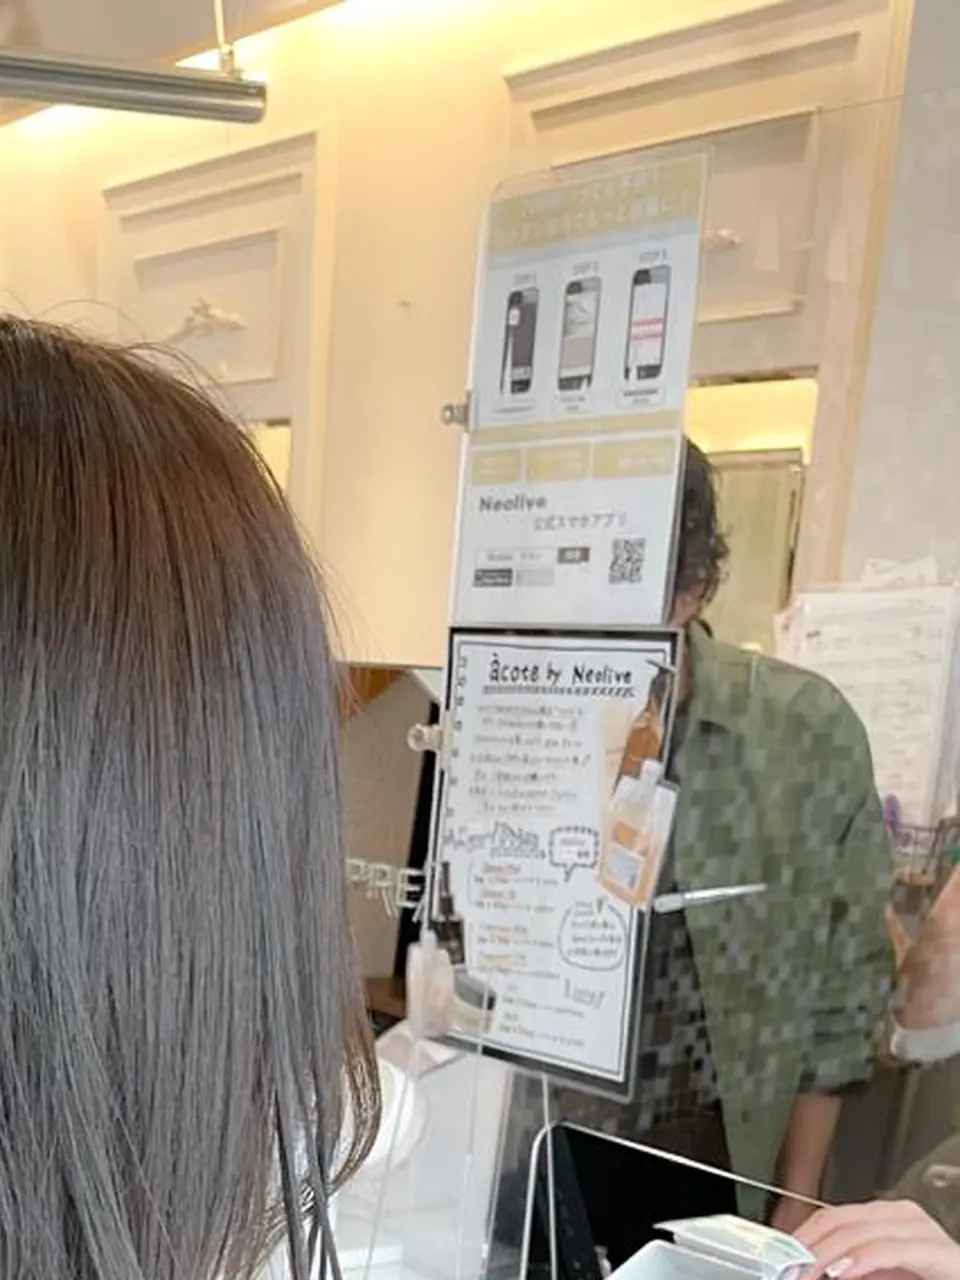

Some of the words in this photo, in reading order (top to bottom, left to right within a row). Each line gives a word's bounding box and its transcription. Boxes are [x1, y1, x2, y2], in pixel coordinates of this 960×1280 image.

[479, 494, 548, 512] Neolive
[546, 659, 562, 683] by
[573, 661, 633, 685] Neolive
